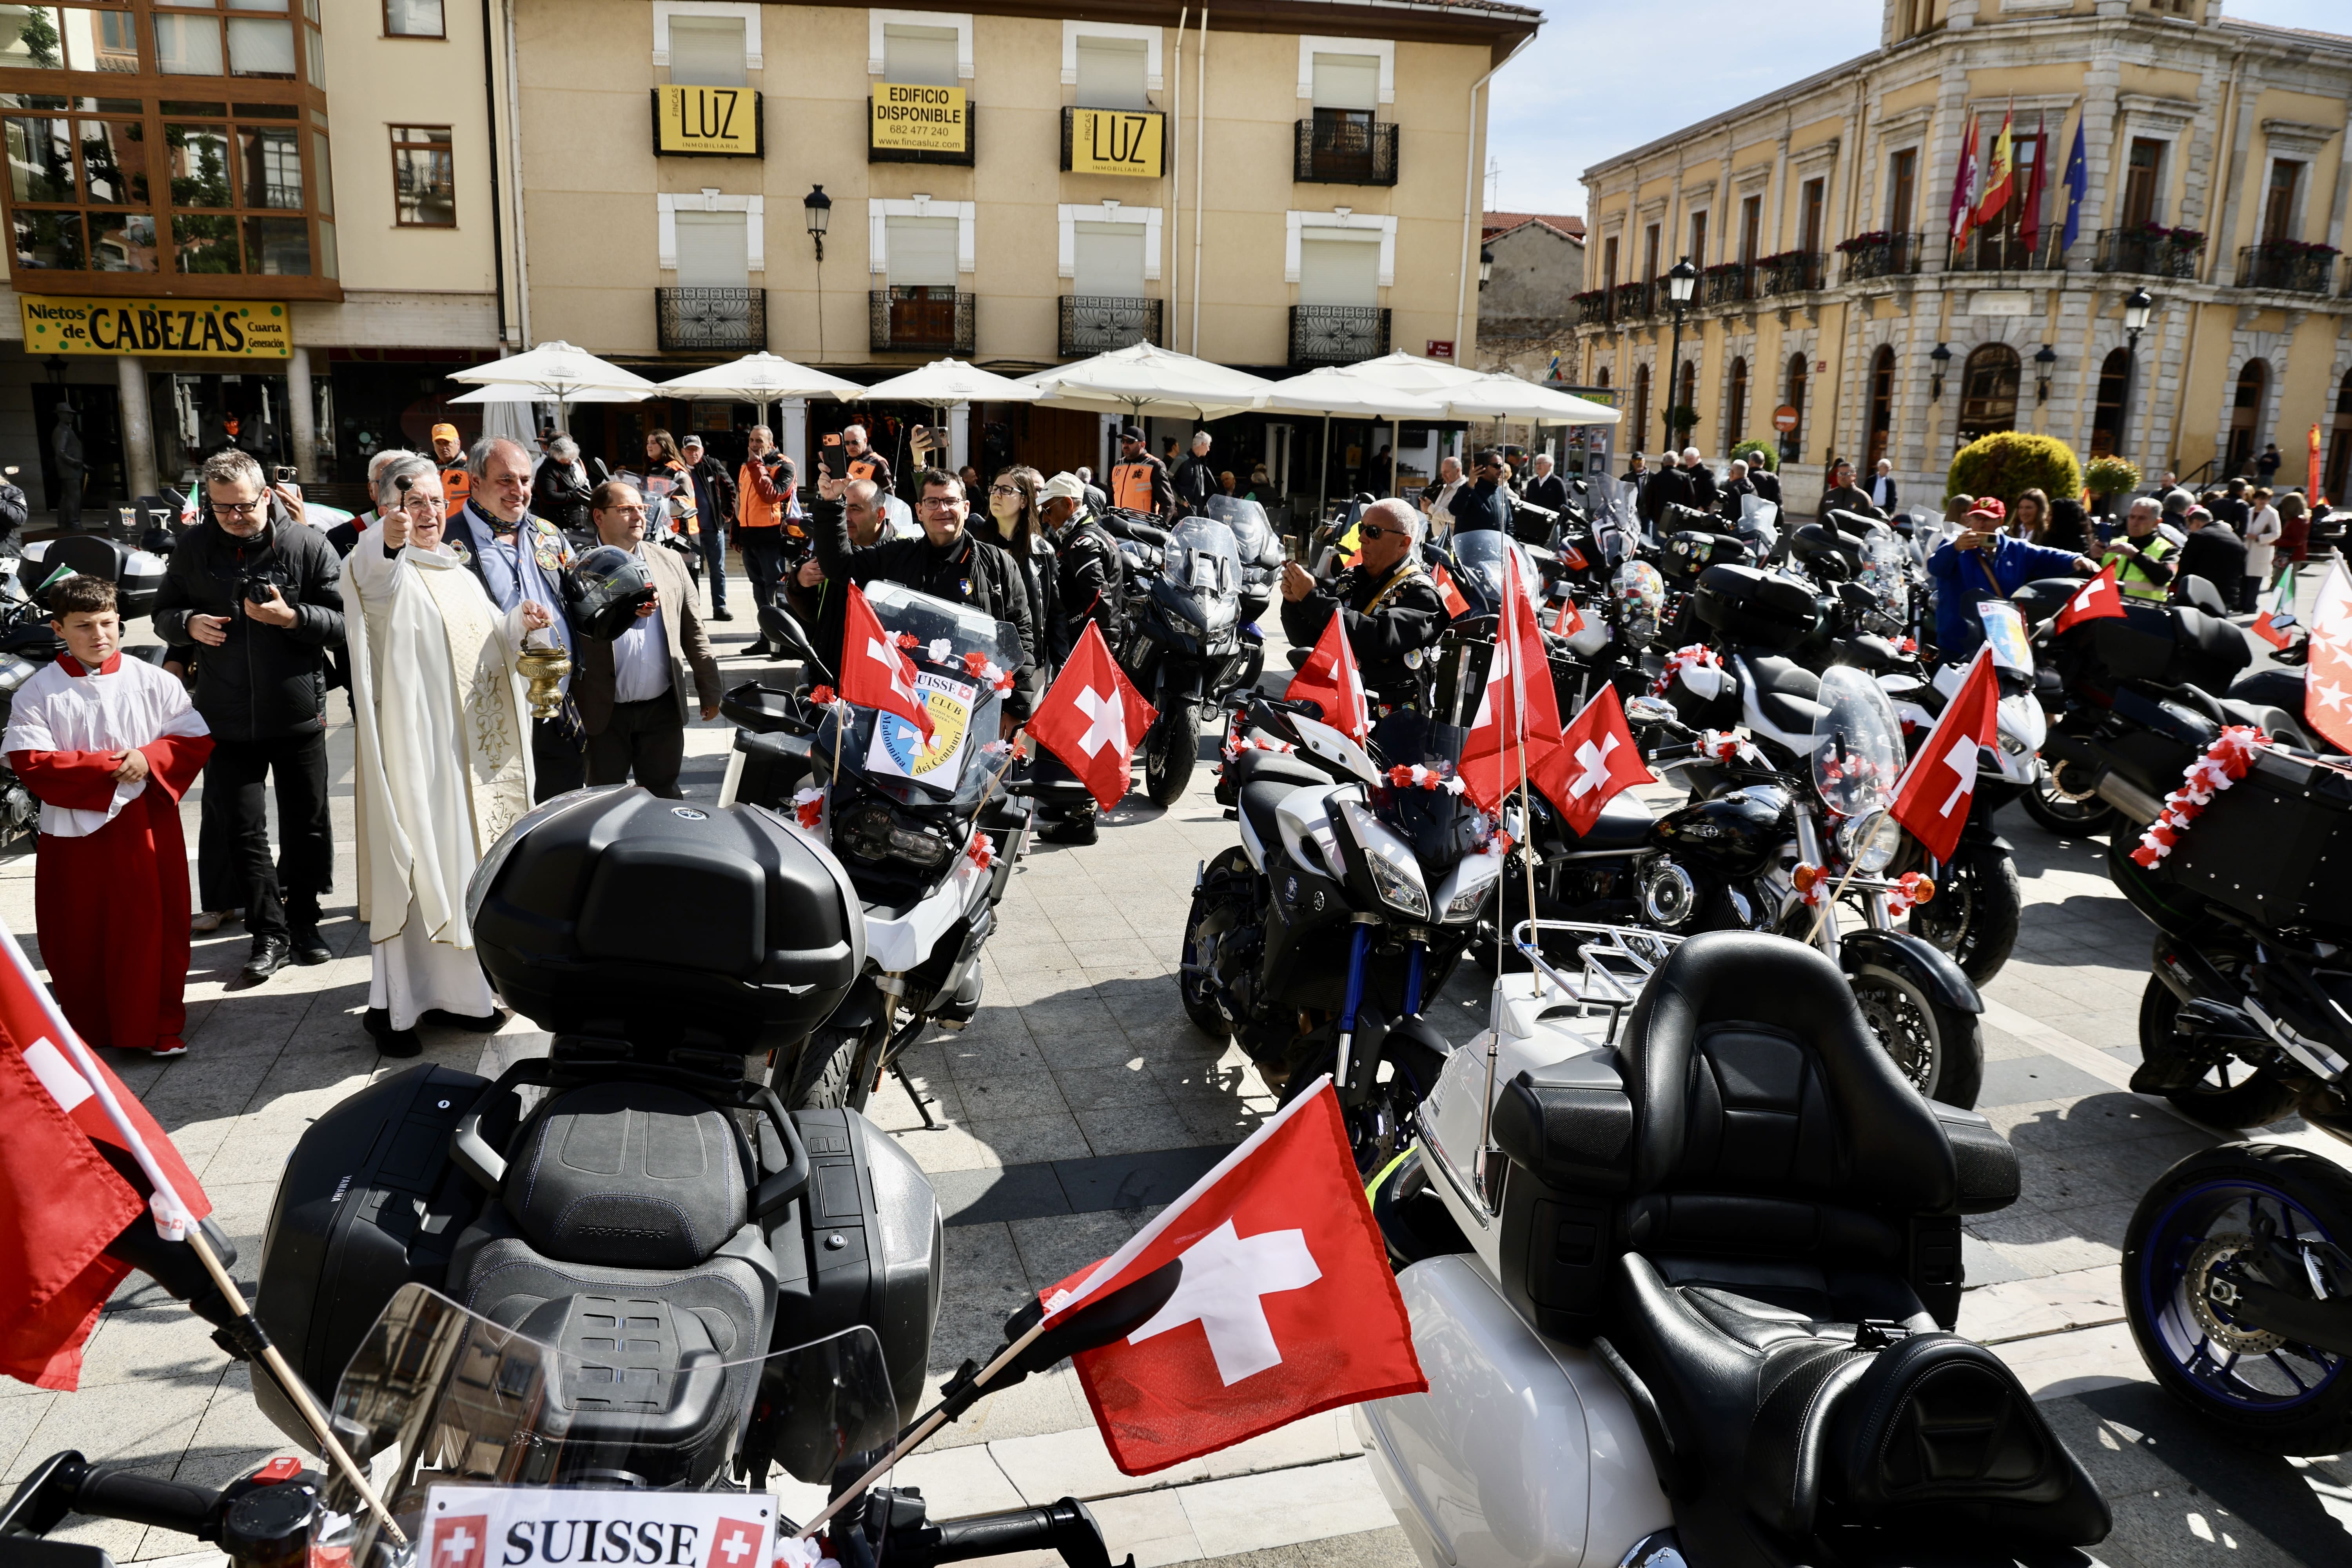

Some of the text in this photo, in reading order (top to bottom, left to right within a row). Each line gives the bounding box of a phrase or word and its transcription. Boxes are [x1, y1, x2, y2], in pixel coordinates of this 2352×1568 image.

[890, 87, 949, 104] EDIFICIO
[681, 88, 739, 139] LUZ
[877, 105, 961, 123] DISPONIBLE
[890, 124, 949, 136] 682 477 240
[1093, 113, 1147, 163] LUZ
[878, 138, 960, 148] www.fincasluz.com
[1093, 165, 1145, 173] INMOBILIARIA
[27, 304, 86, 320] Nietos
[62, 324, 85, 339] de
[89, 308, 244, 352] CABEZAS
[247, 321, 282, 332] Cuarta
[249, 338, 285, 348] Generación
[1068, 612, 1083, 625] TECH
[914, 675, 956, 694] UISSE
[932, 696, 962, 715] CLUB
[928, 707, 964, 727] SEKTION SCHWEIZ
[929, 712, 950, 724] SVIZZERA
[883, 715, 906, 767] Madonnina
[916, 731, 962, 774] dei Centauri
[1271, 889, 1285, 922] TRACER
[330, 1175, 352, 1202] YAMAHA
[503, 1520, 699, 1567] SUISSE
